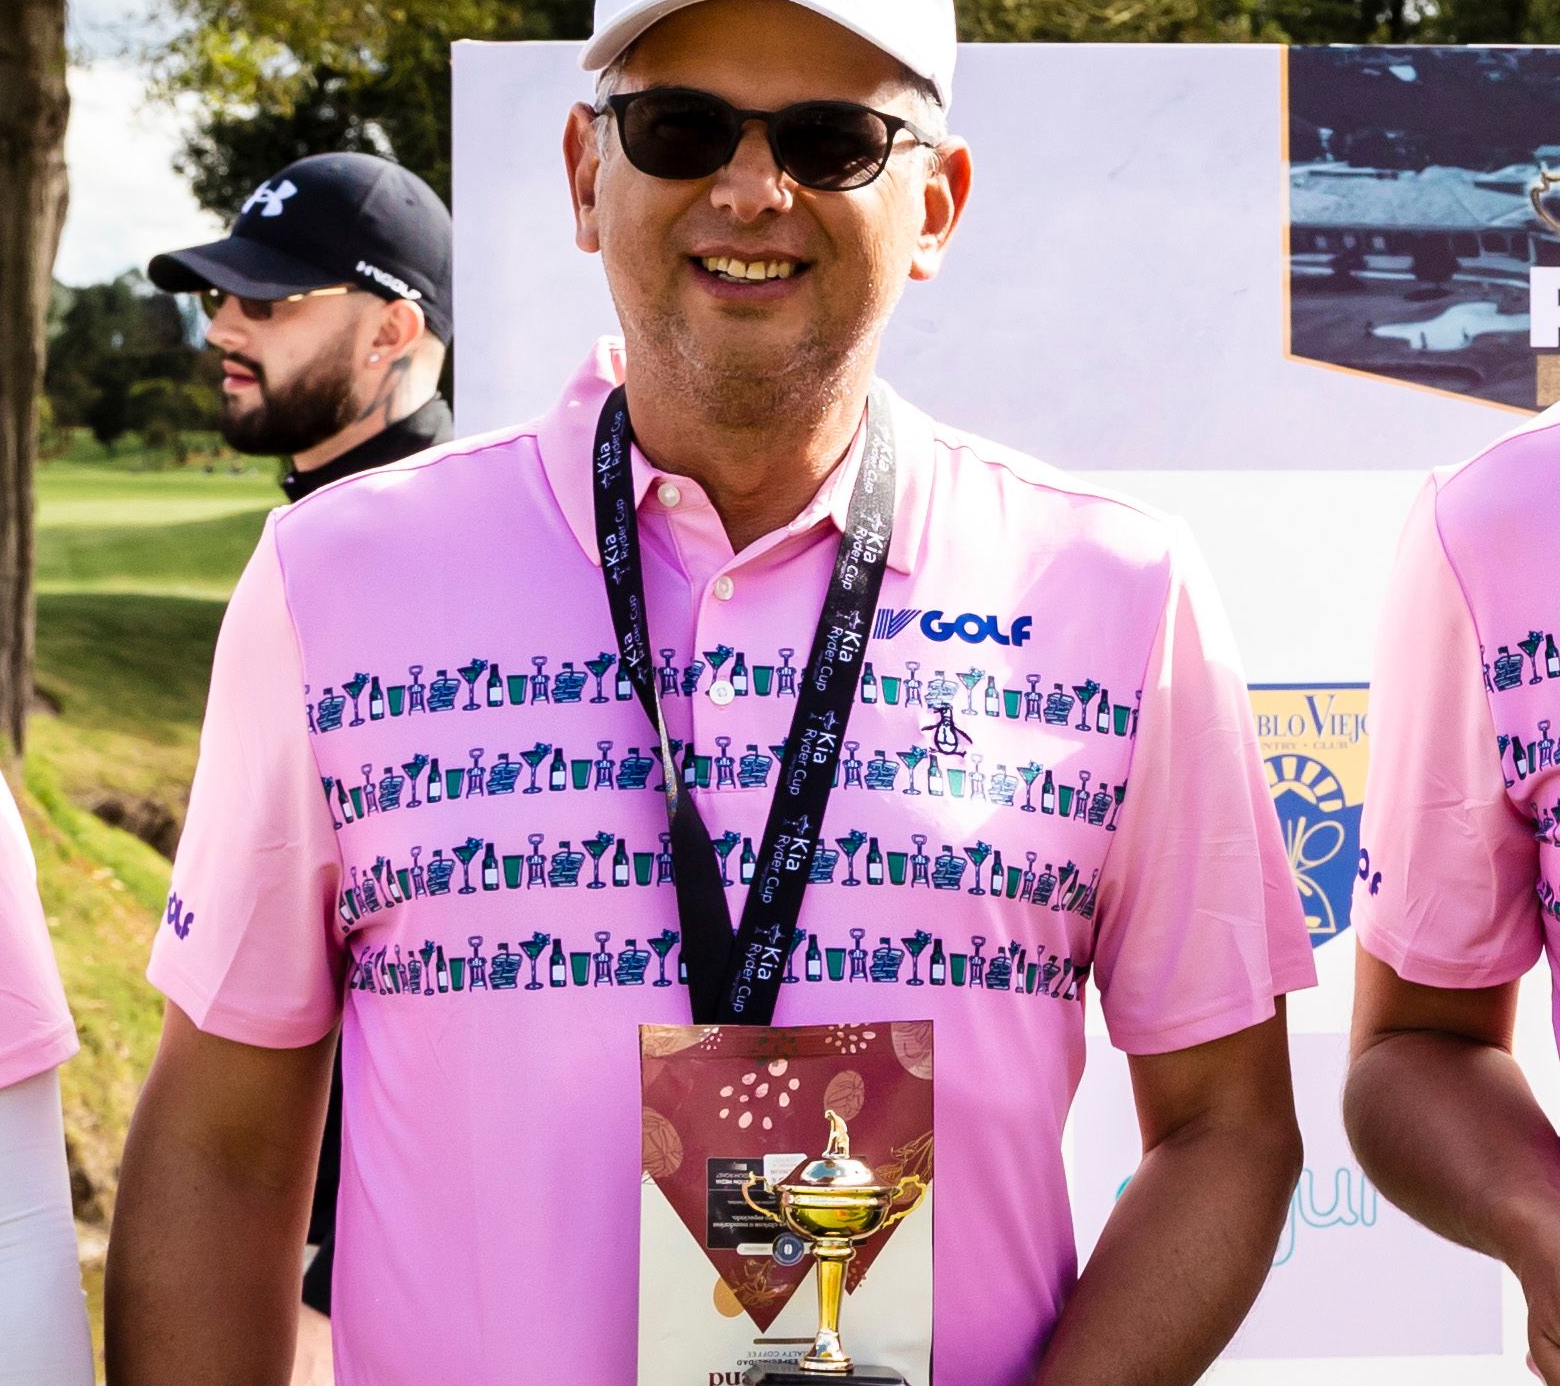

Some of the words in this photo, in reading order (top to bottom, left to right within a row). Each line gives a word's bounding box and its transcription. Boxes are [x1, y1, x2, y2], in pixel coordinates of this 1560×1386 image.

[597, 442, 610, 473] Kia
[616, 498, 625, 522] Cup
[605, 533, 619, 567] Kia
[864, 531, 886, 563] Kia
[842, 565, 859, 591] Cup
[920, 610, 1033, 647] GOLF
[624, 632, 639, 667] Kia
[839, 630, 861, 663] Kia
[816, 665, 833, 692] Cup
[813, 732, 836, 765] Kia
[790, 769, 806, 796] Cup
[785, 837, 810, 871] Kia
[762, 876, 780, 904] Cup
[757, 946, 782, 980] Kia
[734, 985, 751, 1013] Cup
